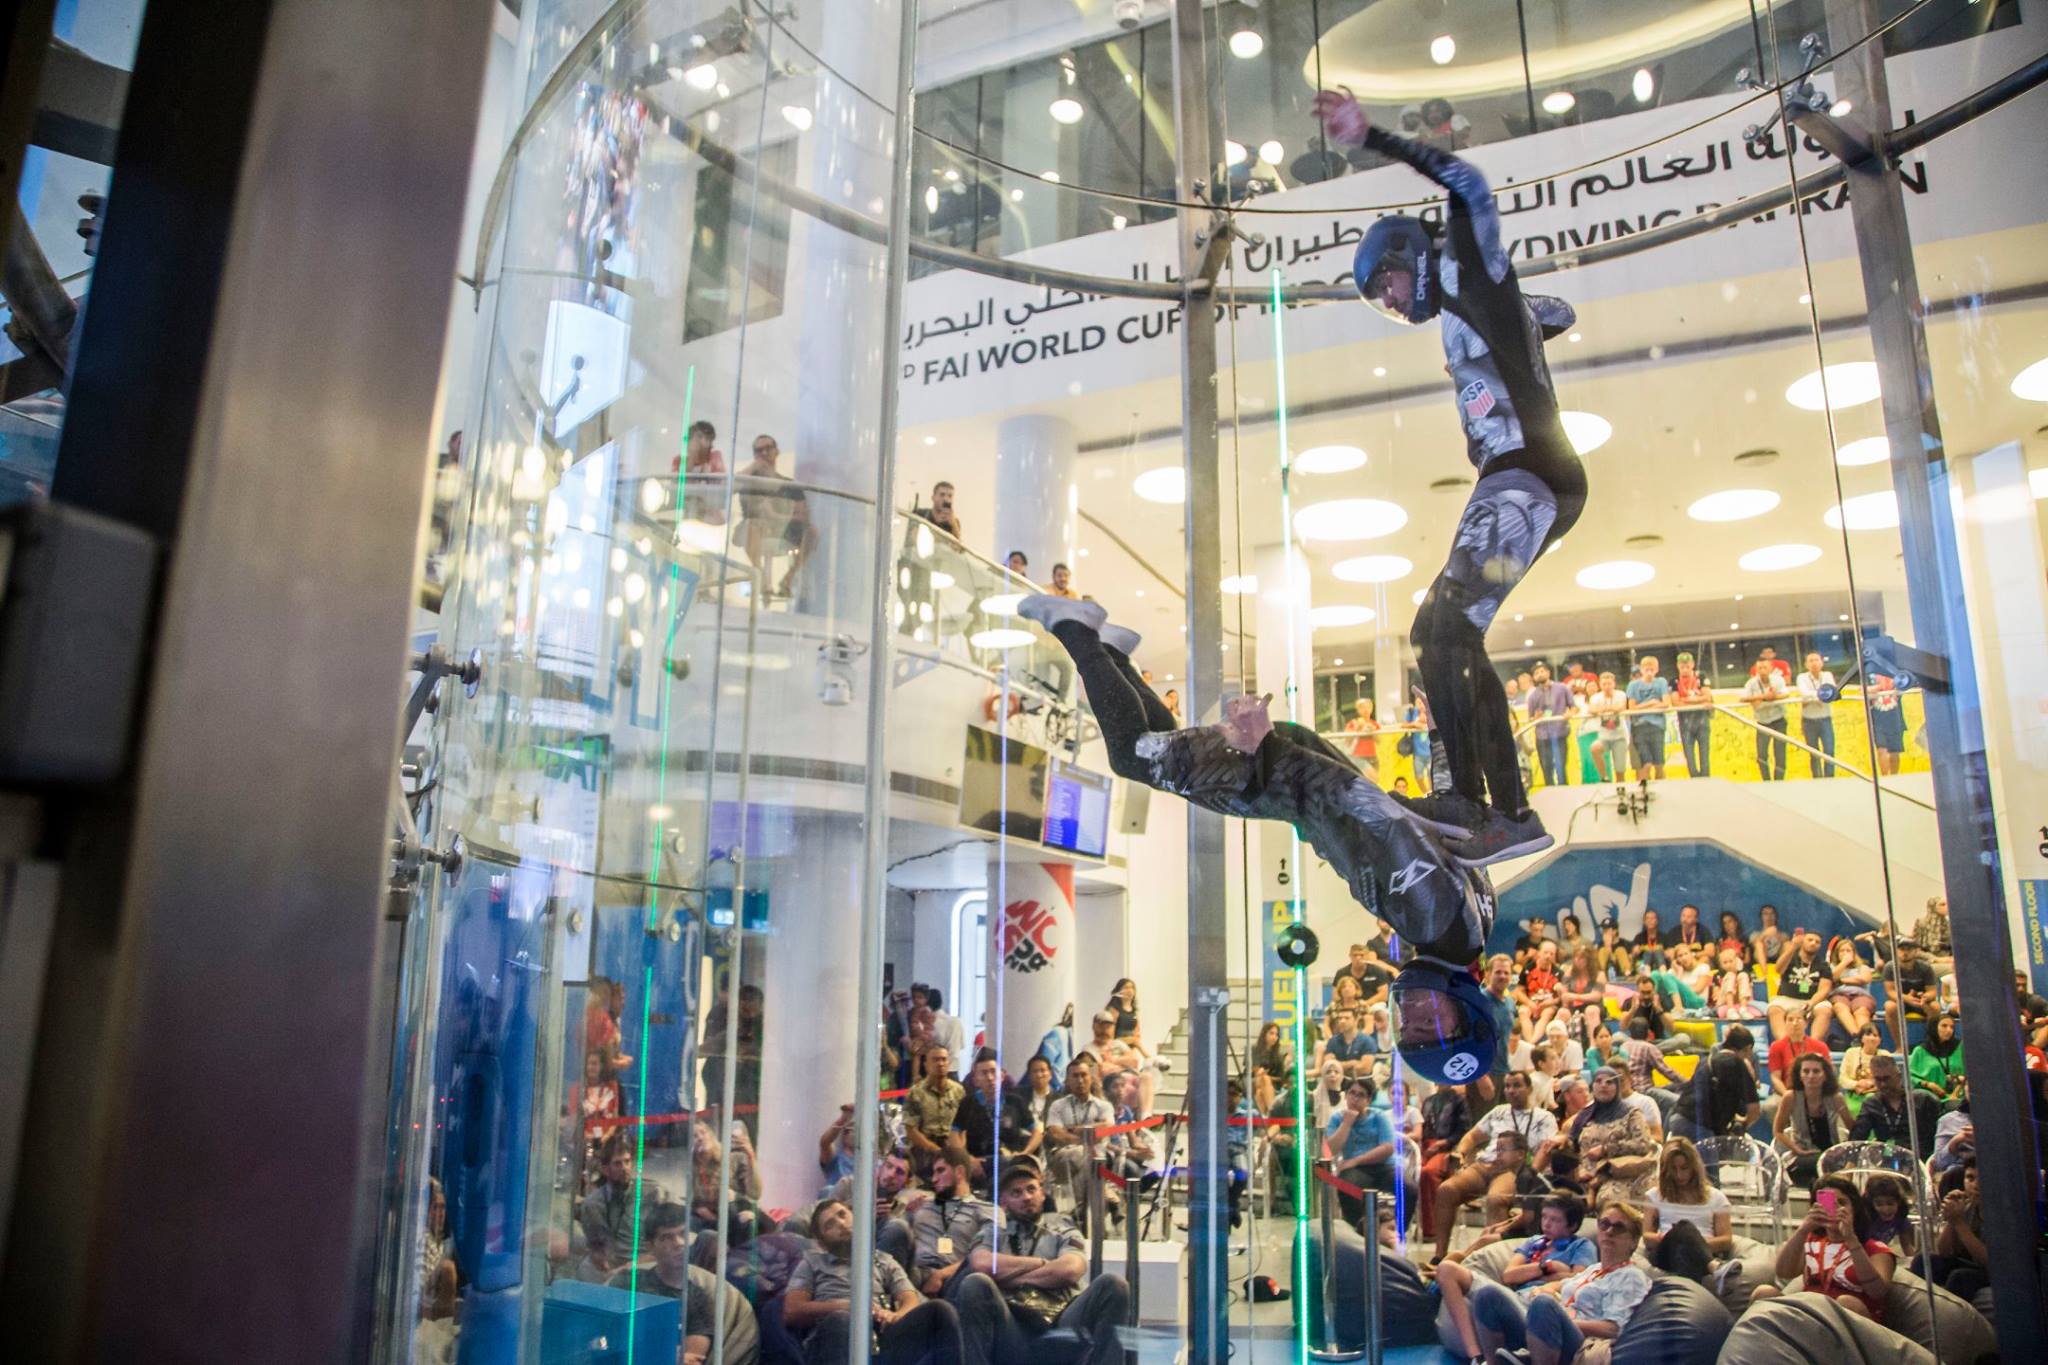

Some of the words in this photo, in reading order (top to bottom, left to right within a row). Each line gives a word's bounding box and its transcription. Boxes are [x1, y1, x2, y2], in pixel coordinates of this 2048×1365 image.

[1571, 140, 1732, 208] العالم
[923, 352, 969, 385] FAI
[977, 325, 1107, 373] WORLD
[1117, 306, 1183, 344] CUP
[2025, 882, 2038, 917] FLOOR
[2031, 919, 2044, 965] SECOND
